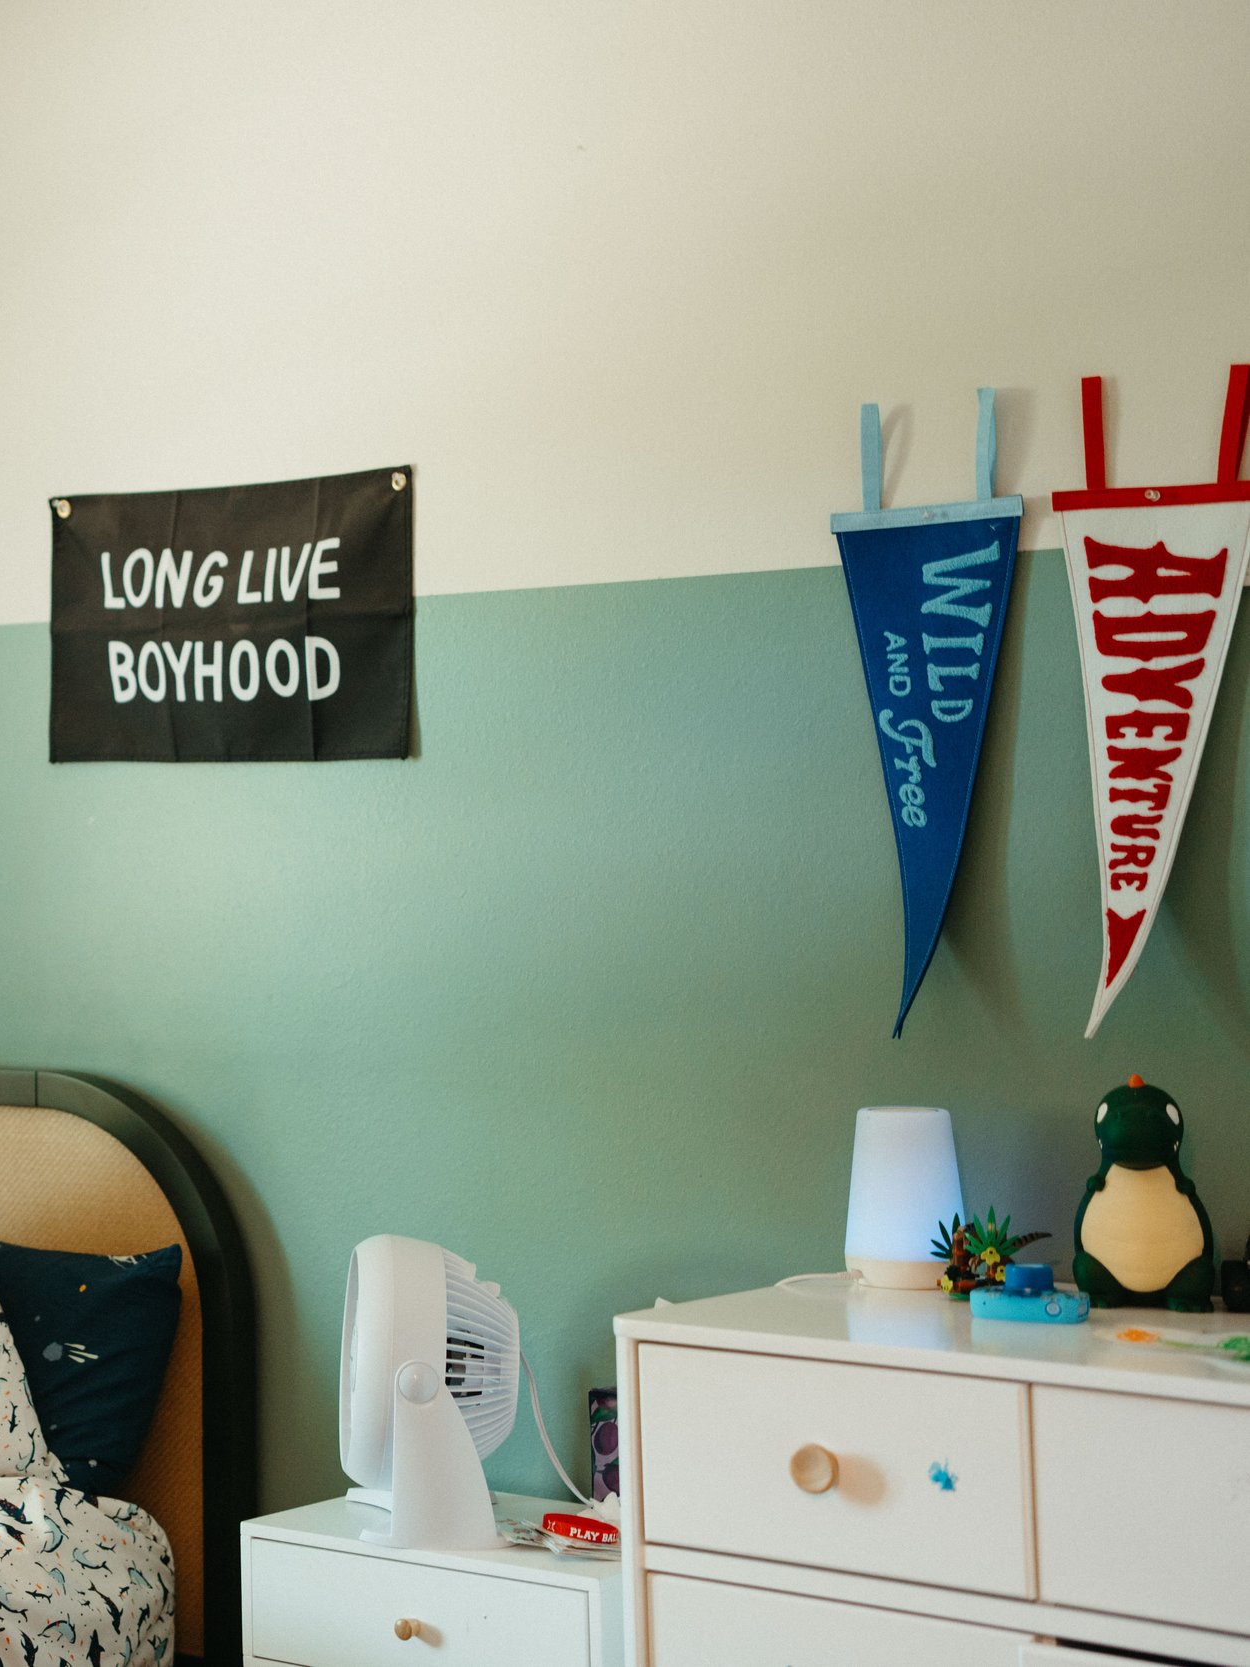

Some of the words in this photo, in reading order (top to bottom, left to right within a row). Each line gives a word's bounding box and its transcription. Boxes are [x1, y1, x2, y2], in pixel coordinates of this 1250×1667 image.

[101, 548, 229, 609] LONG
[237, 537, 341, 604] LIVE
[883, 631, 912, 697] AND
[920, 541, 1001, 723] WILD
[108, 635, 341, 703] BOYHOOD
[1083, 535, 1229, 892] ADVENTURE
[879, 709, 937, 828] Free
[570, 1526, 600, 1541] PLAY
